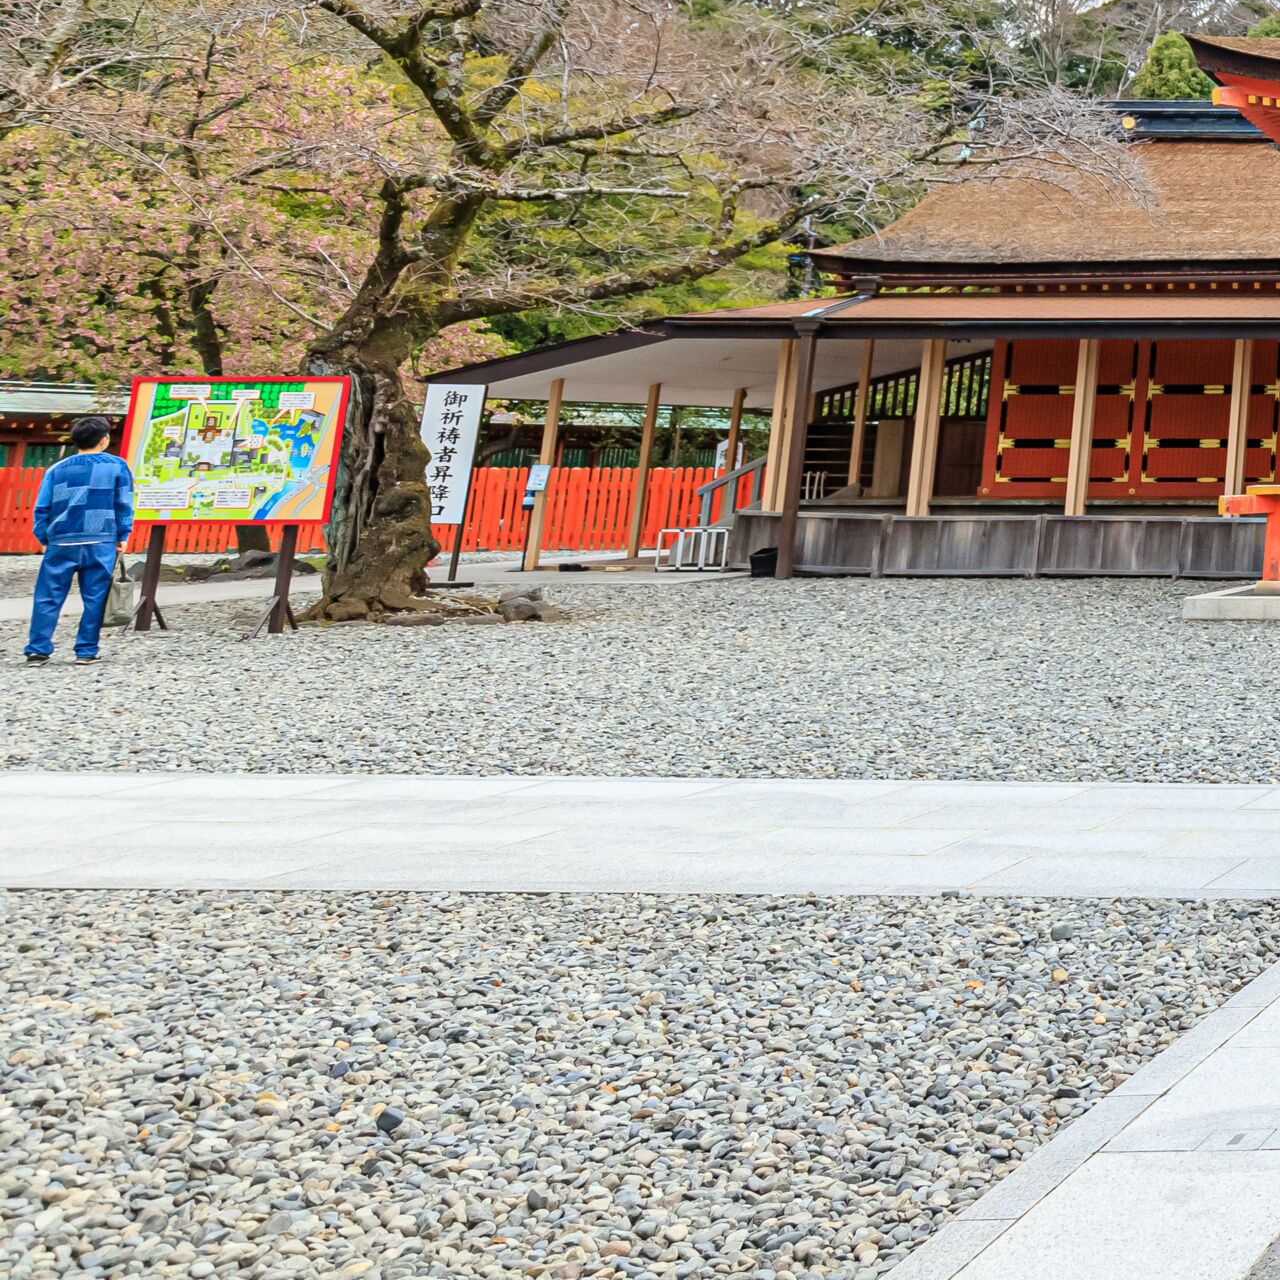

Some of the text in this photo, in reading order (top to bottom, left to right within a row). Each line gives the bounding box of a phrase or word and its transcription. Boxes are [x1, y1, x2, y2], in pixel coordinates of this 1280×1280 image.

[429, 390, 468, 516] 御祈祷者昇降口
